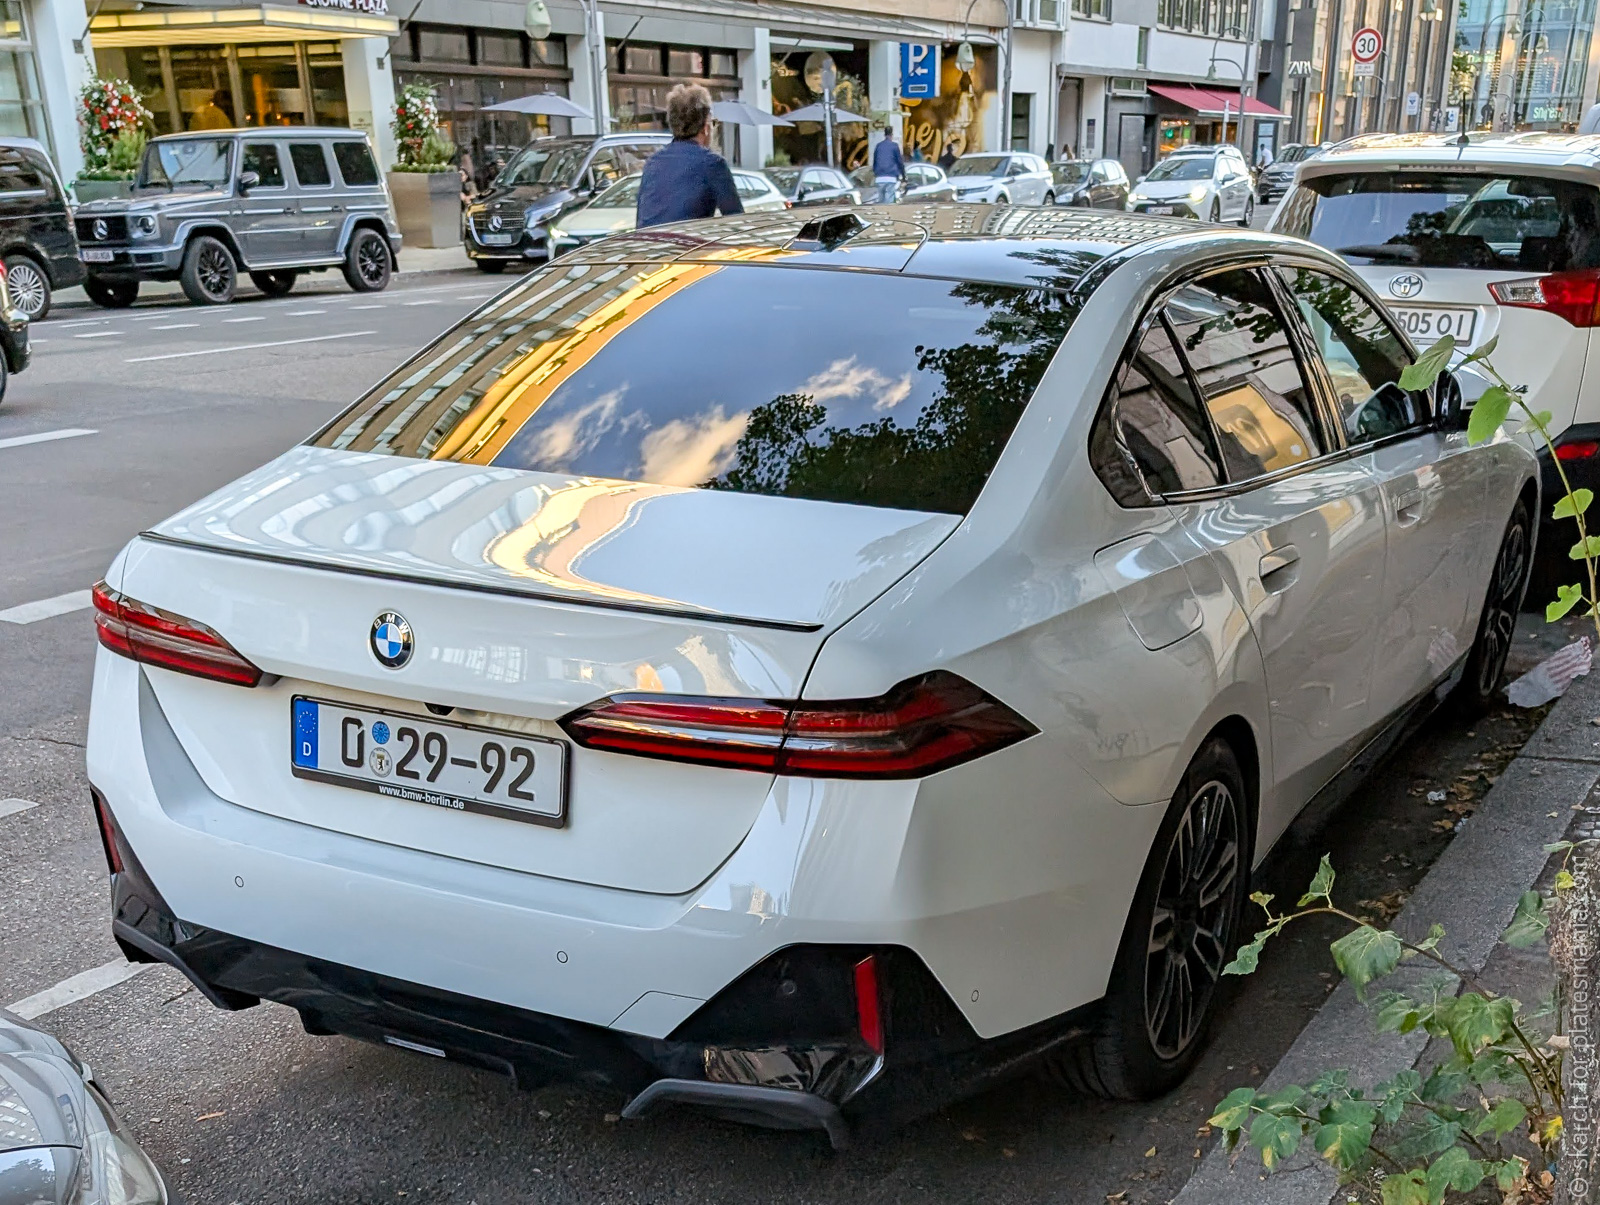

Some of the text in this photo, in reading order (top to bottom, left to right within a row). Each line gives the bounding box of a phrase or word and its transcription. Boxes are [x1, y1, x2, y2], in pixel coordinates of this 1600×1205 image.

[356, 0, 389, 12] PLAZA
[1358, 37, 1376, 54] 30
[908, 43, 929, 77] P
[1288, 60, 1312, 75] ZARA
[374, 613, 409, 634] BMW
[302, 742, 312, 757] D
[396, 727, 535, 802] 29-92
[379, 785, 465, 809] www.bmw-berlin.de
